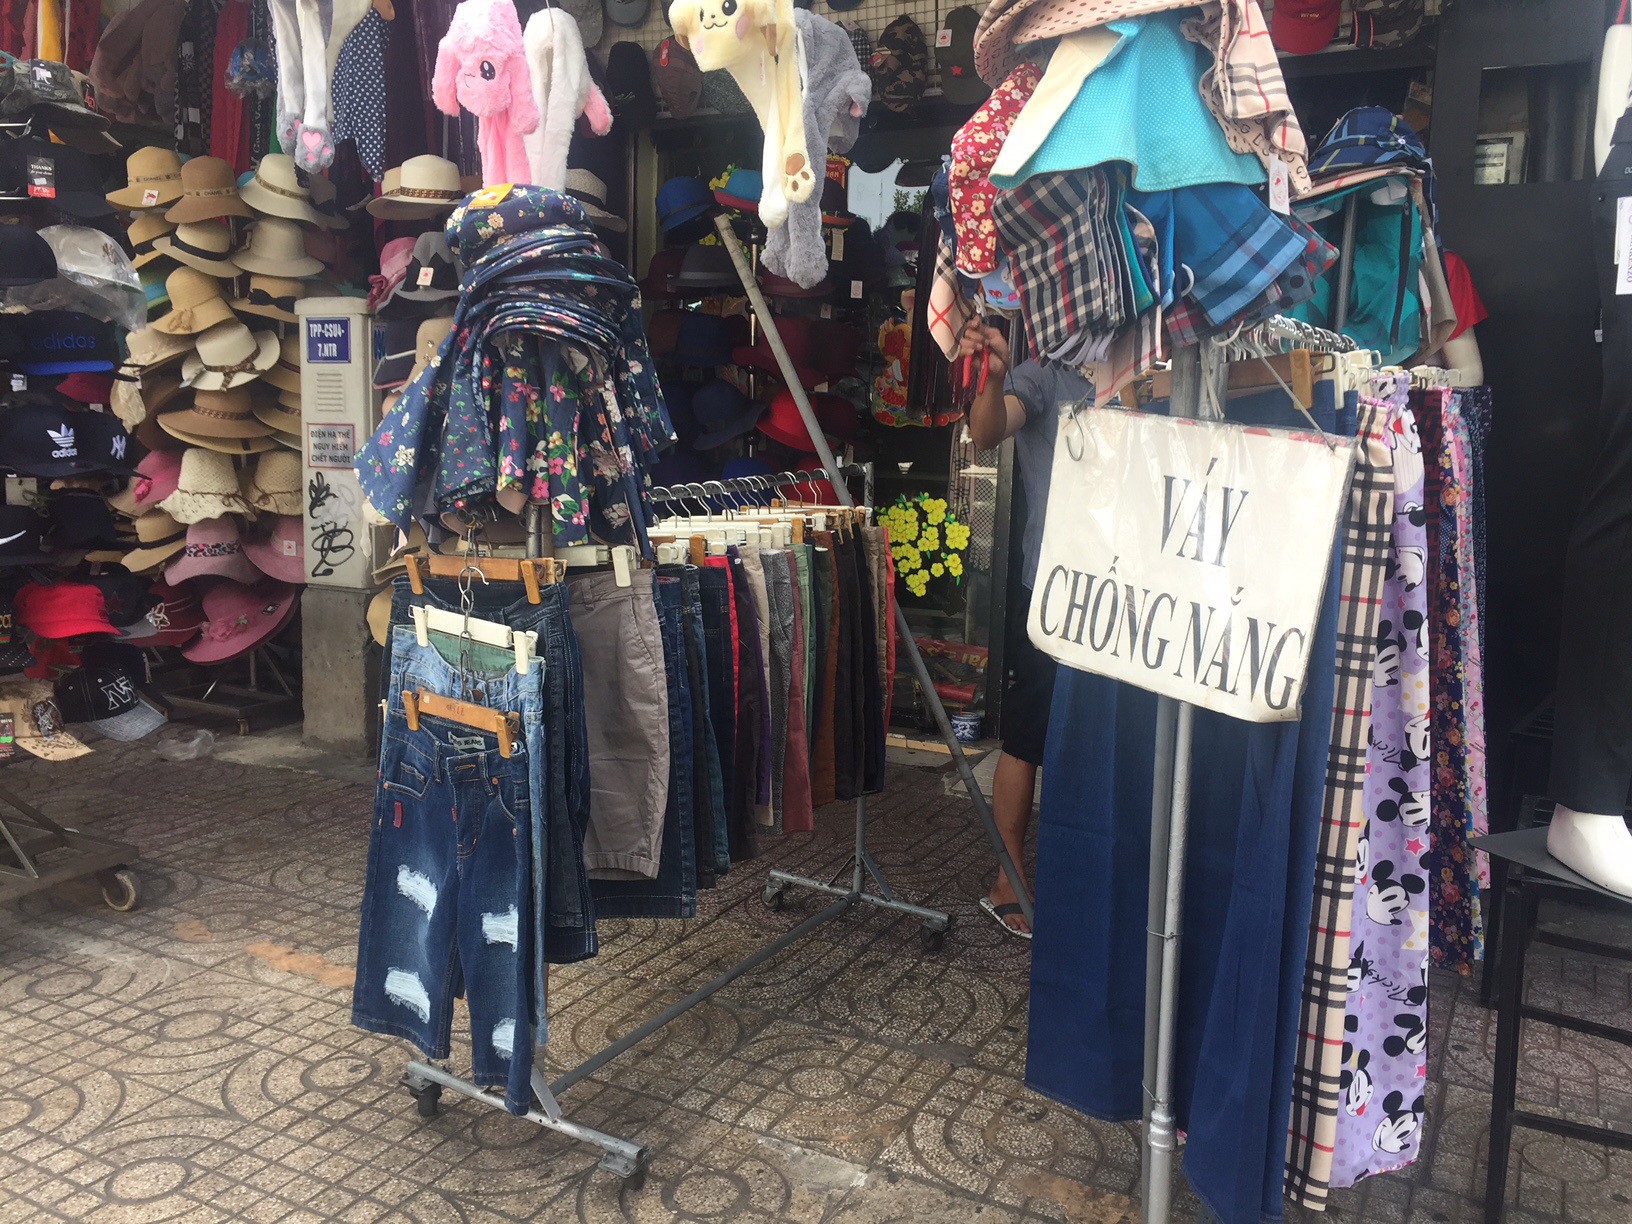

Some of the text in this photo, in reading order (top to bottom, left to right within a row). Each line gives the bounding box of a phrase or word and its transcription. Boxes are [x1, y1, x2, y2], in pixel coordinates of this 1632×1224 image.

[1160, 457, 1249, 568] VÁY
[1040, 555, 1307, 710] CHỐNG NẮNG
